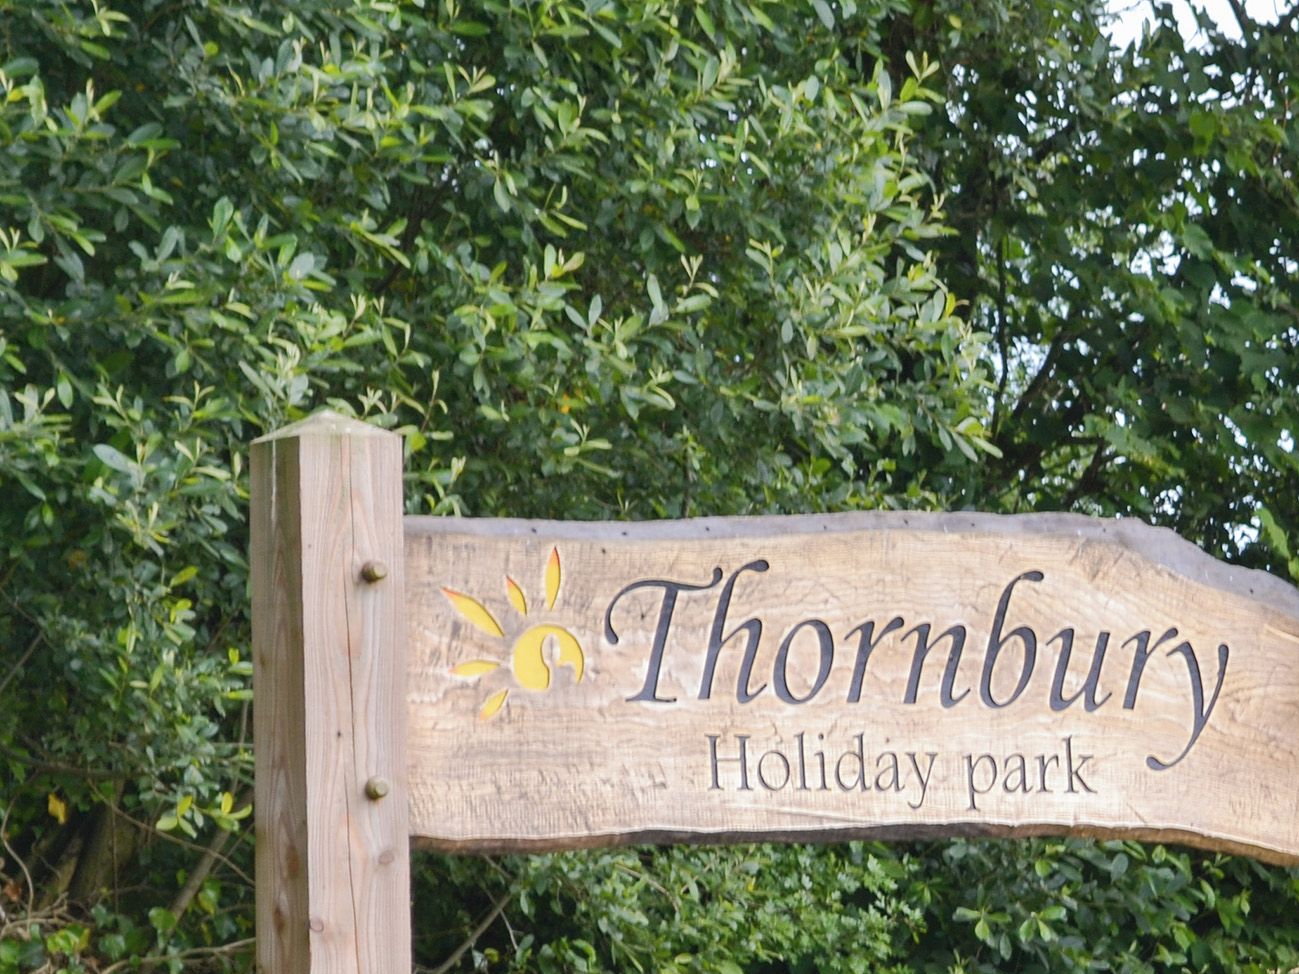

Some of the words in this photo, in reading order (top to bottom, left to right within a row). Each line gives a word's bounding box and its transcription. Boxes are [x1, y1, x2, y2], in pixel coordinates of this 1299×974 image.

[604, 559, 1230, 771] Thornbury
[706, 731, 938, 809] Holiday
[966, 737, 1095, 810] park
